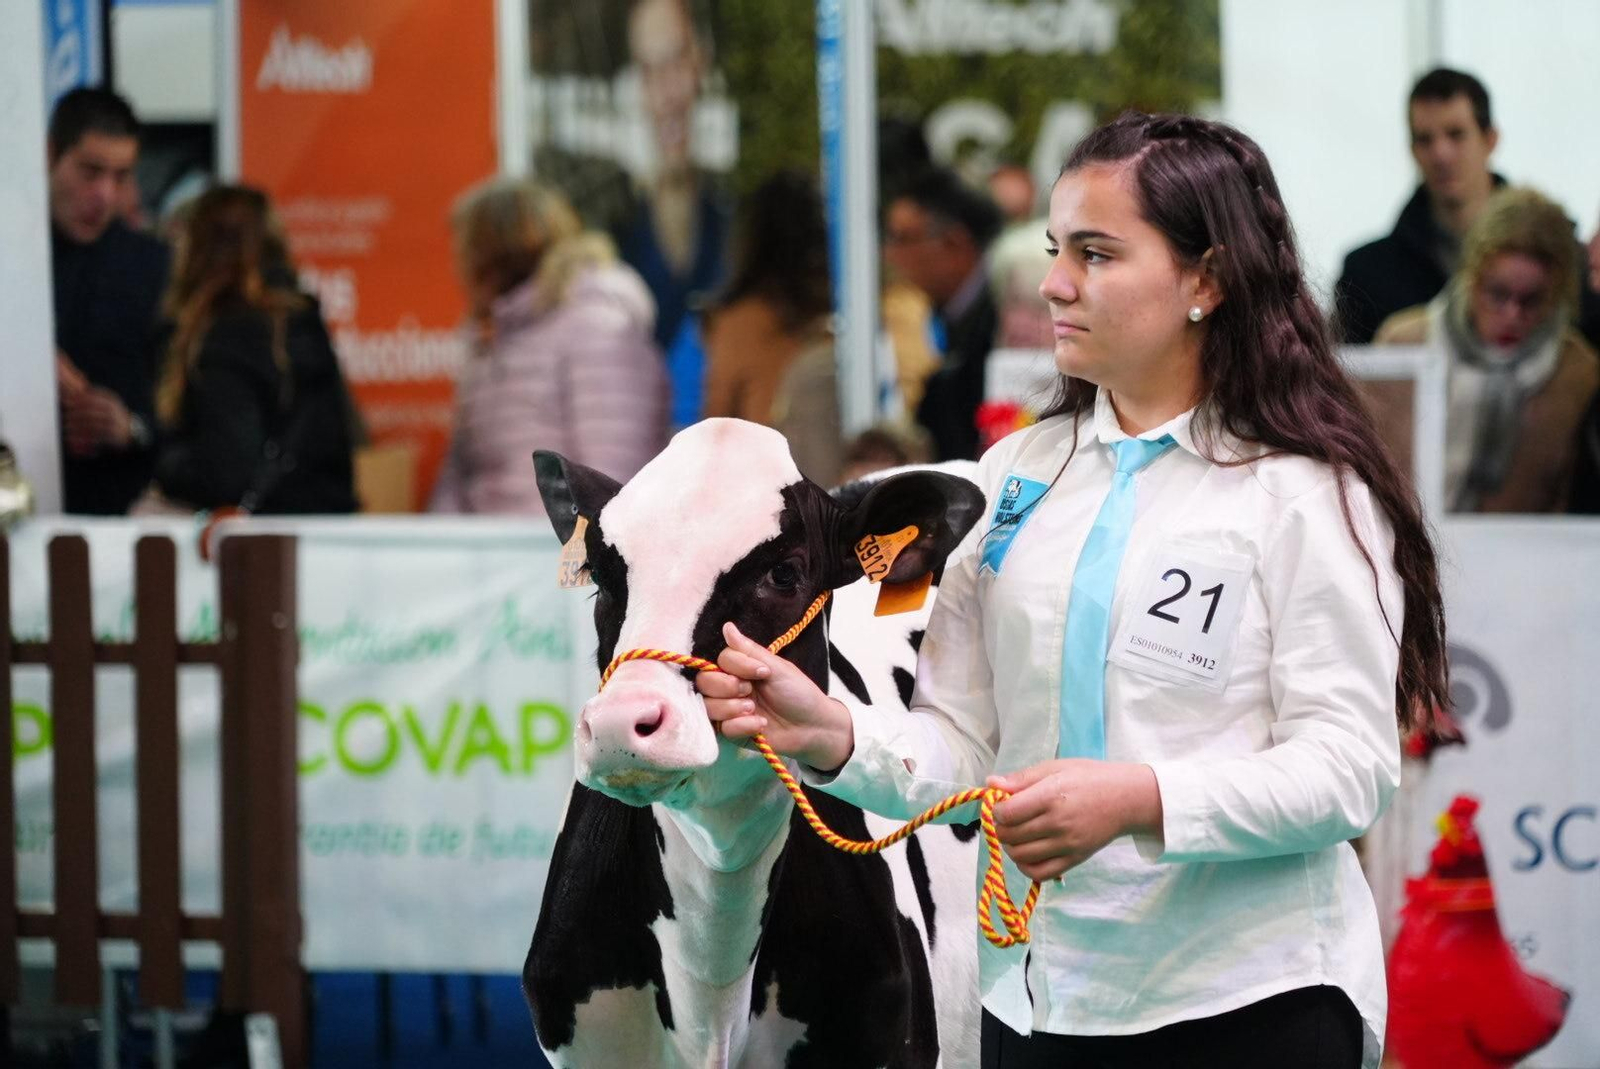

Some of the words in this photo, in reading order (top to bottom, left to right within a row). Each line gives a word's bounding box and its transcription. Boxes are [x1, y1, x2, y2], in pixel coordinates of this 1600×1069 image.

[856, 535, 888, 582] 3912
[1147, 568, 1224, 634] 21
[1187, 653, 1216, 670] 3912
[295, 700, 572, 776] COVAP
